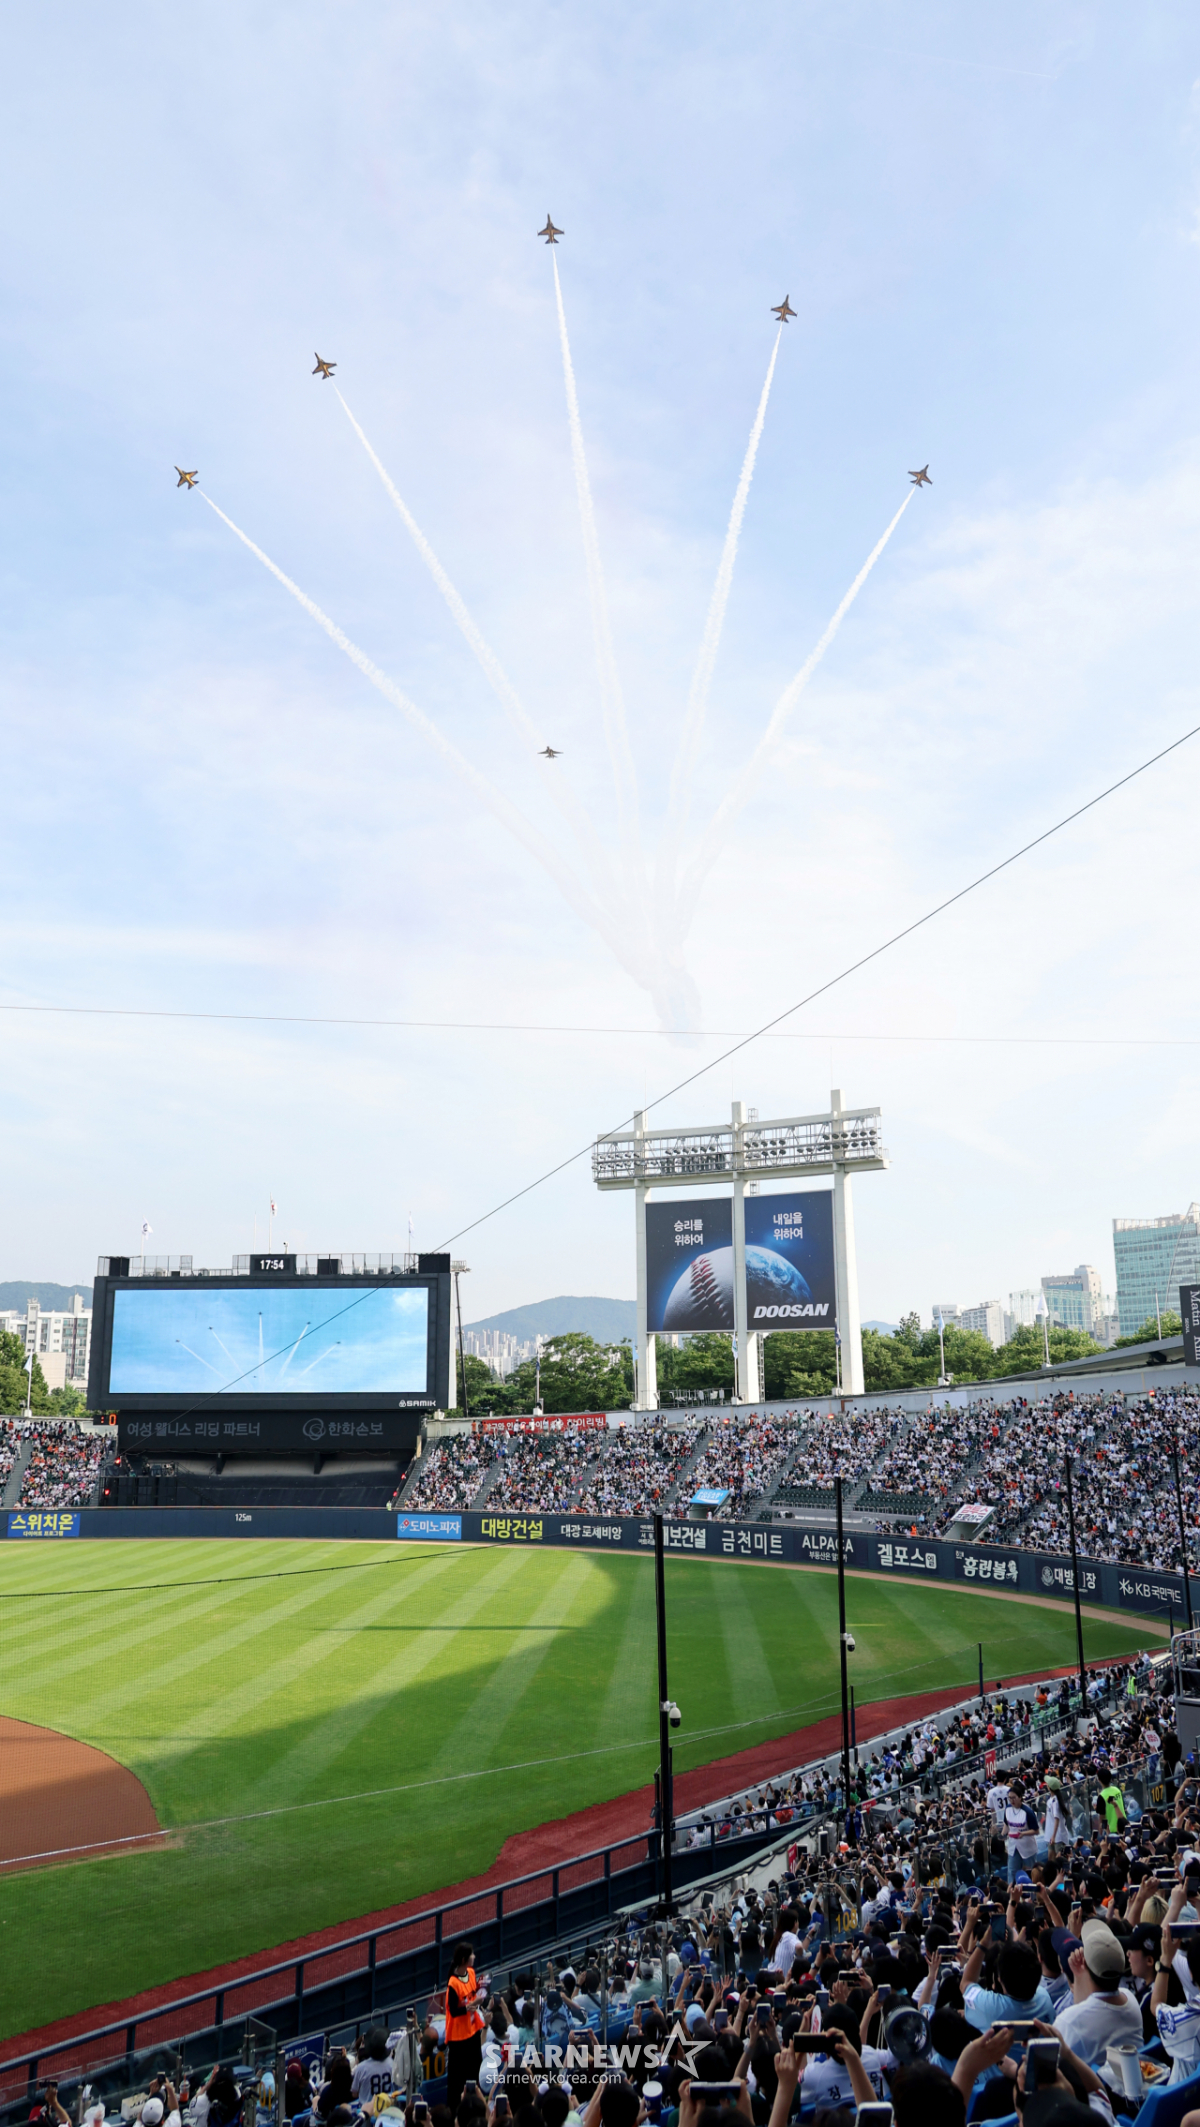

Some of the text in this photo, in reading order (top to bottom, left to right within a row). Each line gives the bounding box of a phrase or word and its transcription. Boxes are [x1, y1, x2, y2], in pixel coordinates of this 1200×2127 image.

[673, 1219, 703, 1232] 승리를
[773, 1212, 803, 1225] 내일을
[674, 1233, 704, 1246] 위하여
[773, 1227, 803, 1240] 위하여
[260, 1259, 284, 1270] 17:54
[753, 1303, 829, 1319] DOOSAN
[127, 1422, 260, 1437] 여성 웰니스 리딩 파트너
[328, 1422, 384, 1436] 한화손보
[11, 1513, 73, 1530] 스위치온
[235, 1513, 252, 1522] 125m
[409, 1520, 460, 1534] 도미노피자
[481, 1518, 543, 1540] 대방건설
[560, 1524, 581, 1538] 대광
[722, 1530, 783, 1555] 금천미트
[877, 1543, 925, 1568] 겔포스
[1135, 1583, 1182, 1603] KB국민카드
[1151, 1784, 1164, 1803] 107
[836, 1908, 858, 1933] 108
[370, 2072, 392, 2095] 82
